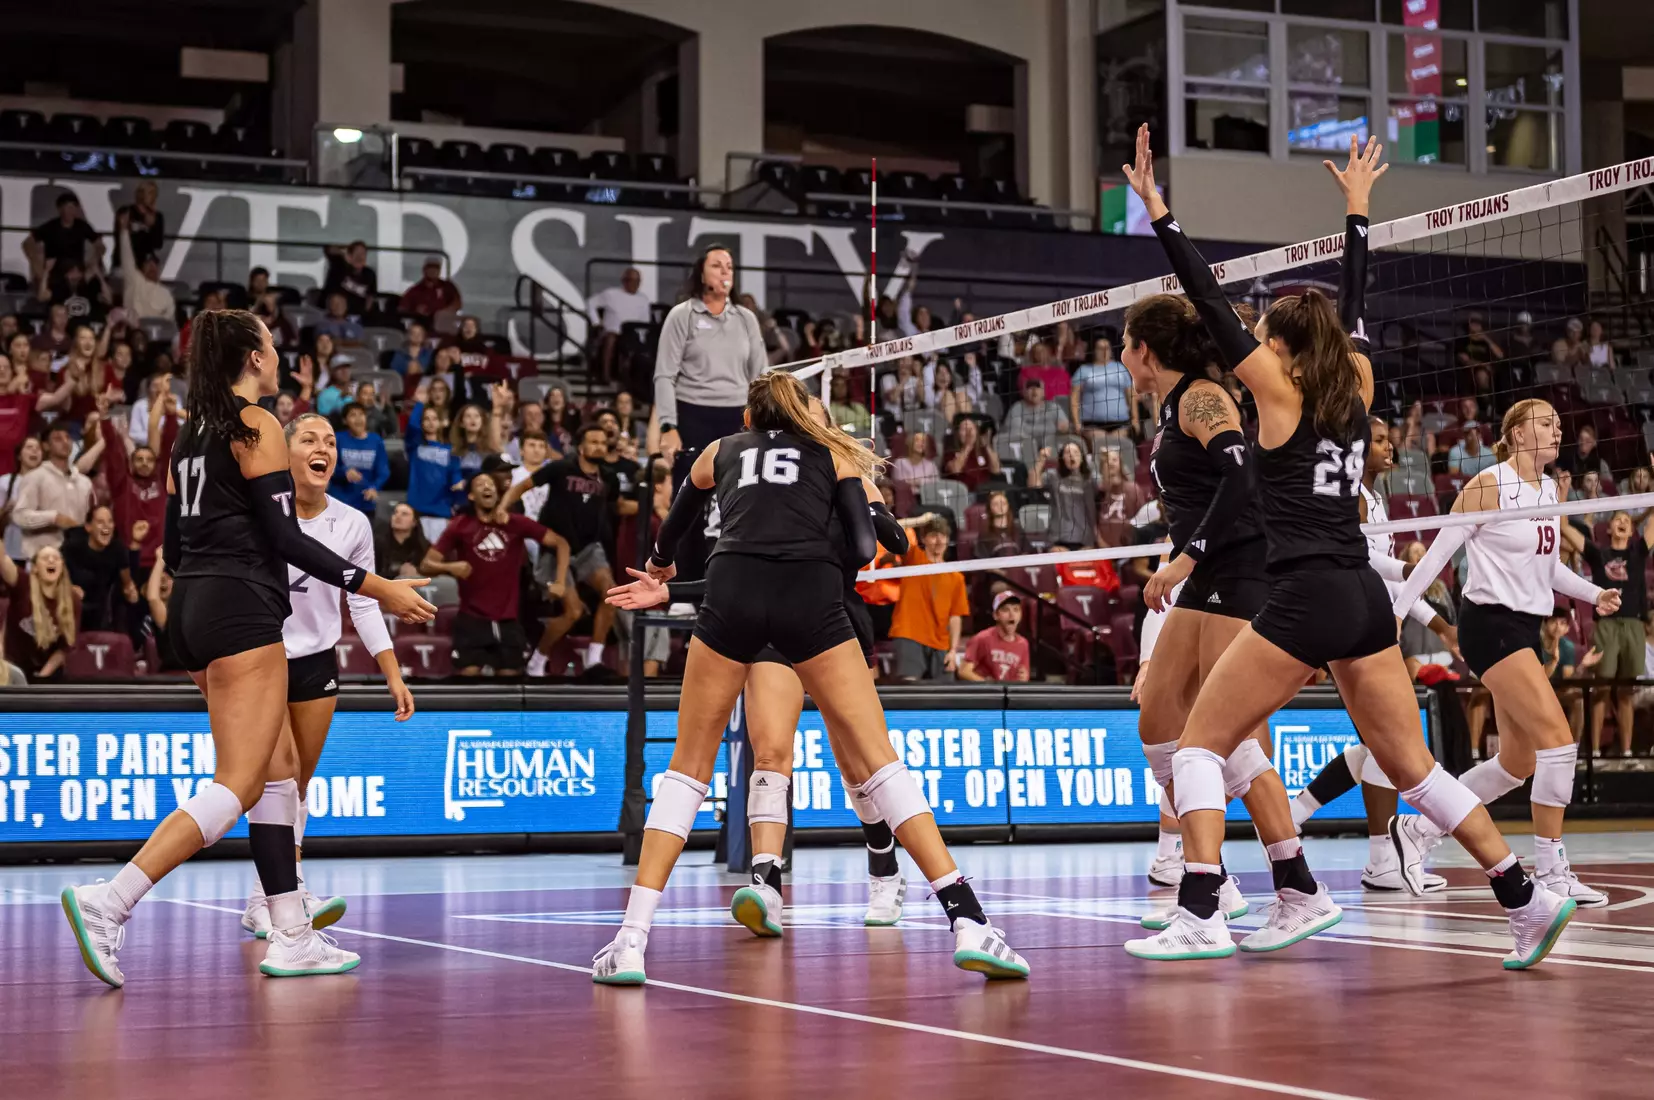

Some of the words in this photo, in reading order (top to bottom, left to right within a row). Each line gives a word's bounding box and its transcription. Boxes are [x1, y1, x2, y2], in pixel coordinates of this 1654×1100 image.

[1587, 166, 1621, 191] TROY
[1425, 207, 1455, 230] TROY
[1457, 194, 1509, 222] TROJANS
[1285, 243, 1310, 264] TROY
[1313, 235, 1346, 256] TROJA
[1161, 275, 1182, 292] TRO
[1052, 302, 1071, 318] TROY
[1073, 291, 1109, 313] TROJANS
[954, 325, 972, 341] TROY
[974, 316, 1005, 336] TROJANS
[738, 448, 800, 489] 16
[1313, 438, 1365, 497] 24
[177, 456, 207, 517] 17
[1536, 525, 1556, 555] 19
[96, 732, 216, 775] PAREN
[458, 748, 595, 779] HUMAN
[888, 728, 981, 768] OSTER
[993, 728, 1107, 767] PARENT
[60, 779, 156, 822] OPEN
[306, 775, 386, 820] OME
[458, 777, 596, 797] RESOURCES
[965, 769, 1046, 807] OPEN
[1056, 767, 1133, 806] YOUR
